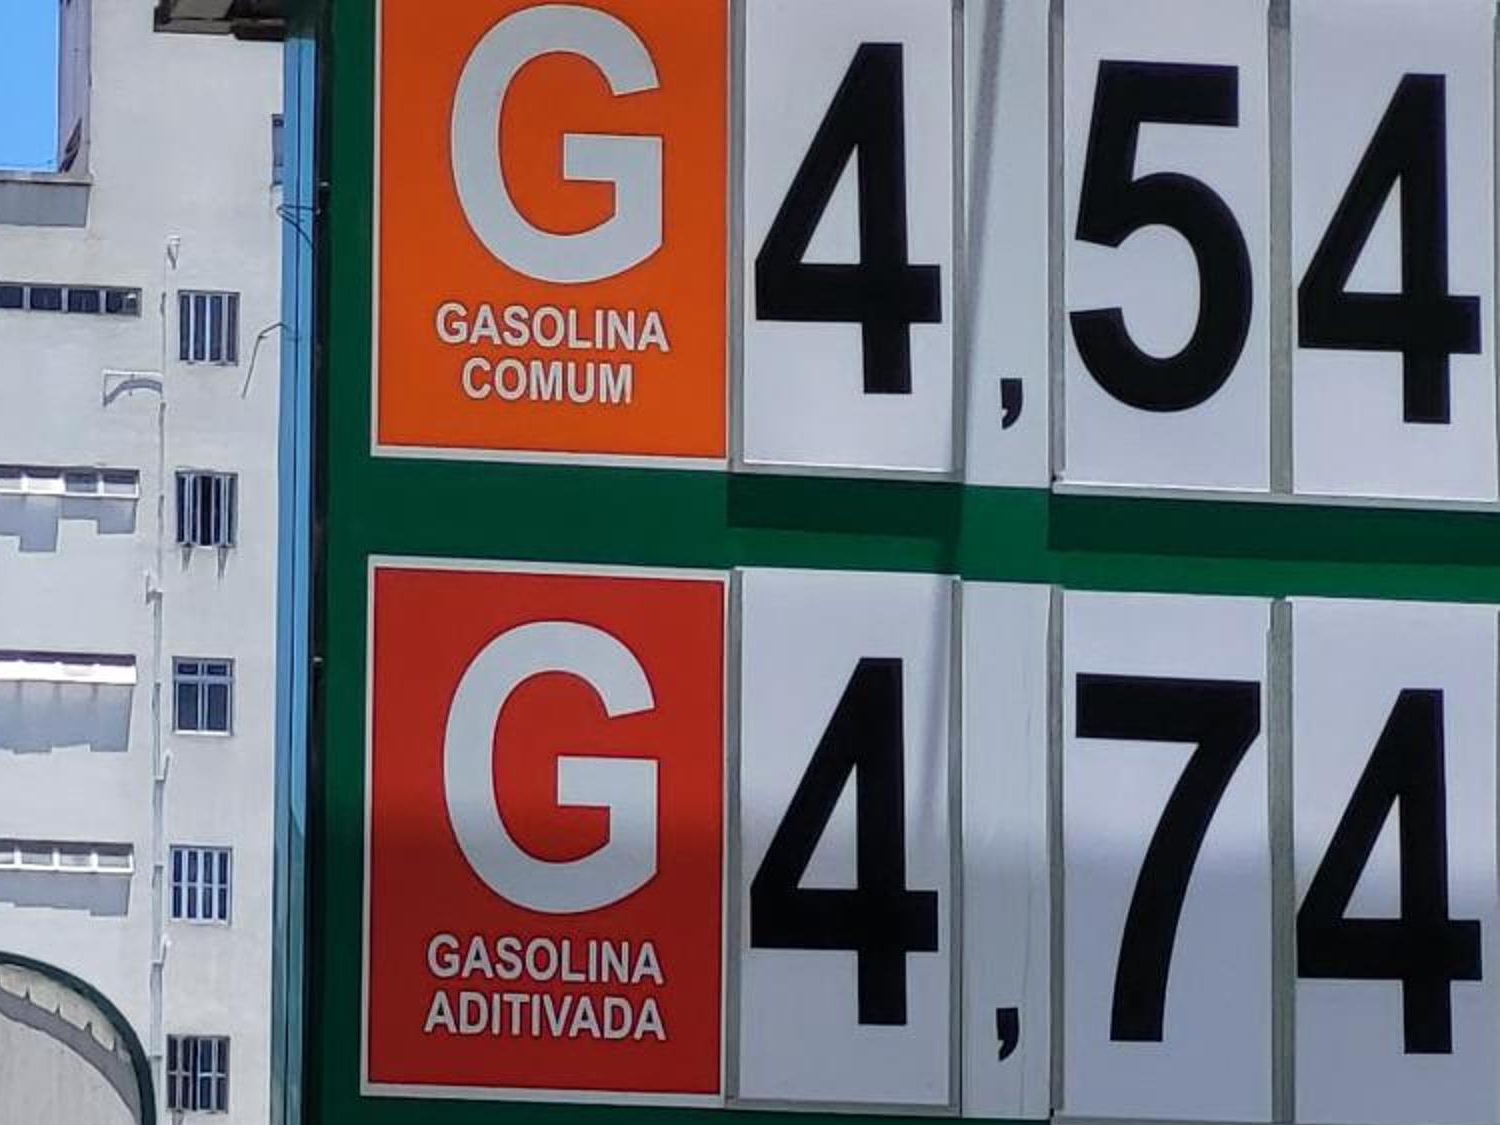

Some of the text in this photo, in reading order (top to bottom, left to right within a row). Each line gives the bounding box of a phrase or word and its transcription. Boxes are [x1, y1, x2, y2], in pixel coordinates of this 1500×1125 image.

[450, 3, 663, 284] G
[435, 302, 670, 352] GASOLINA
[461, 357, 634, 404] COMUM
[442, 619, 659, 914] G
[426, 932, 664, 985] GASOLINA
[423, 991, 668, 1041] ADITIVADA
